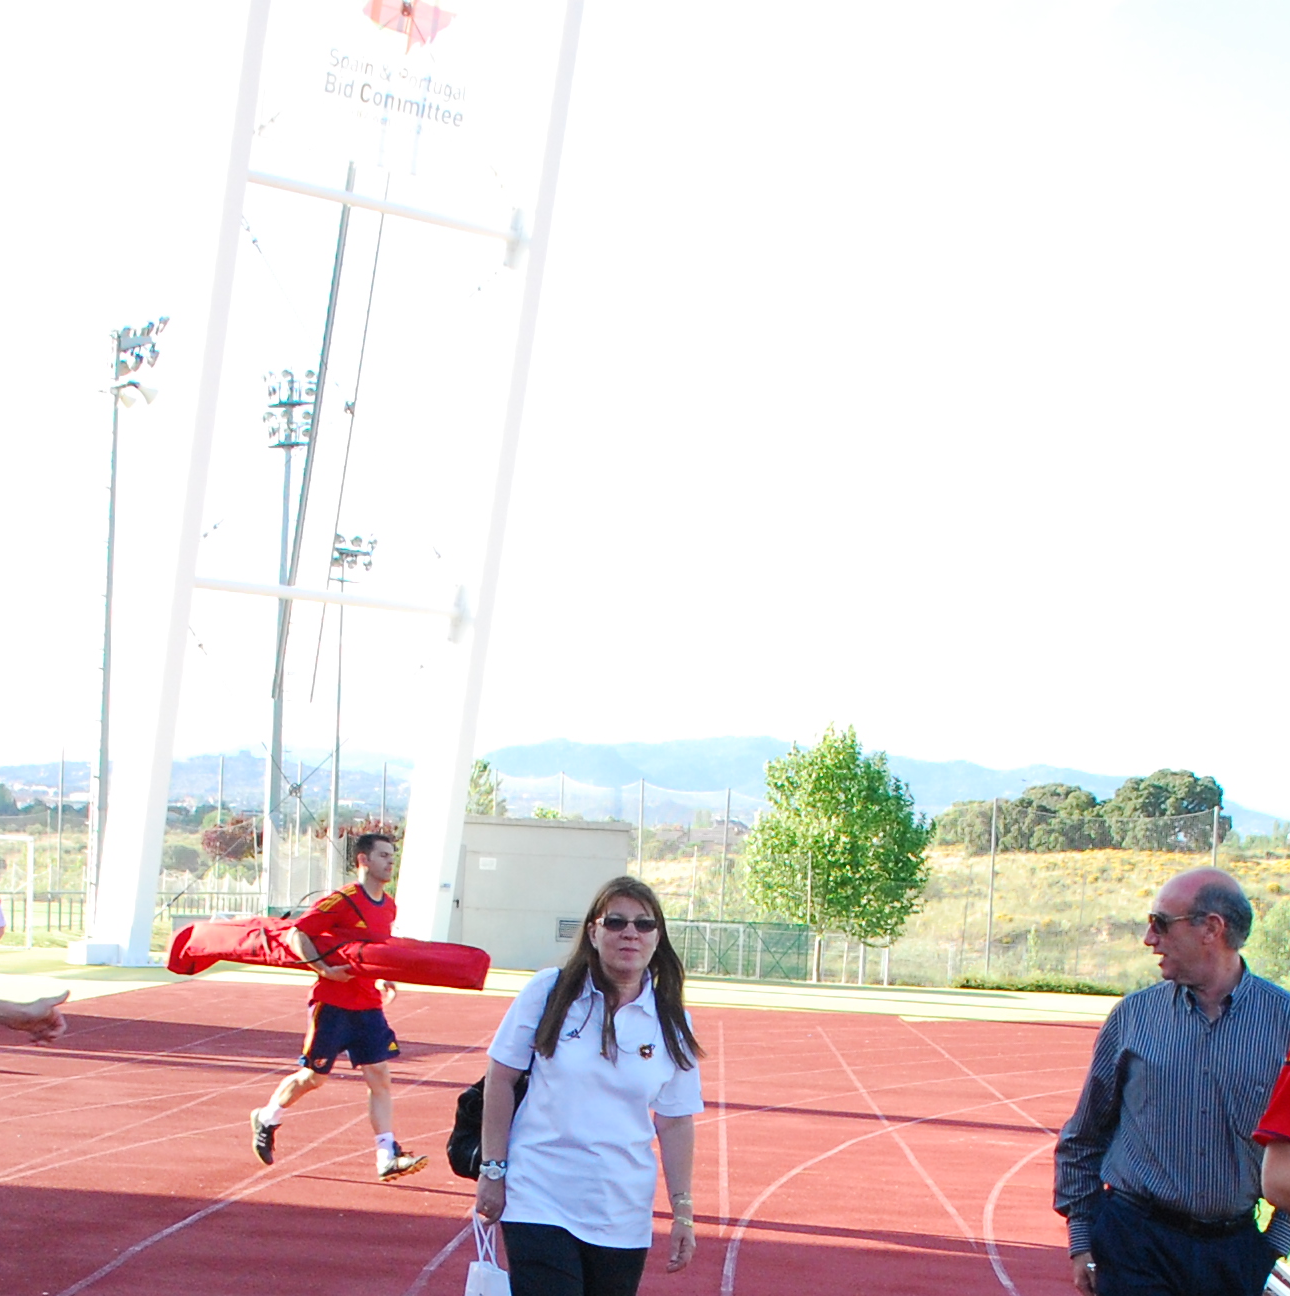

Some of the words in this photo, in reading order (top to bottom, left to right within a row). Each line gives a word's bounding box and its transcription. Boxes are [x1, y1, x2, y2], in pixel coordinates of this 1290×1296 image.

[324, 71, 355, 99] Bid
[360, 82, 464, 127] Committee
[330, 47, 374, 77] Spain
[399, 67, 466, 102] Portugal
